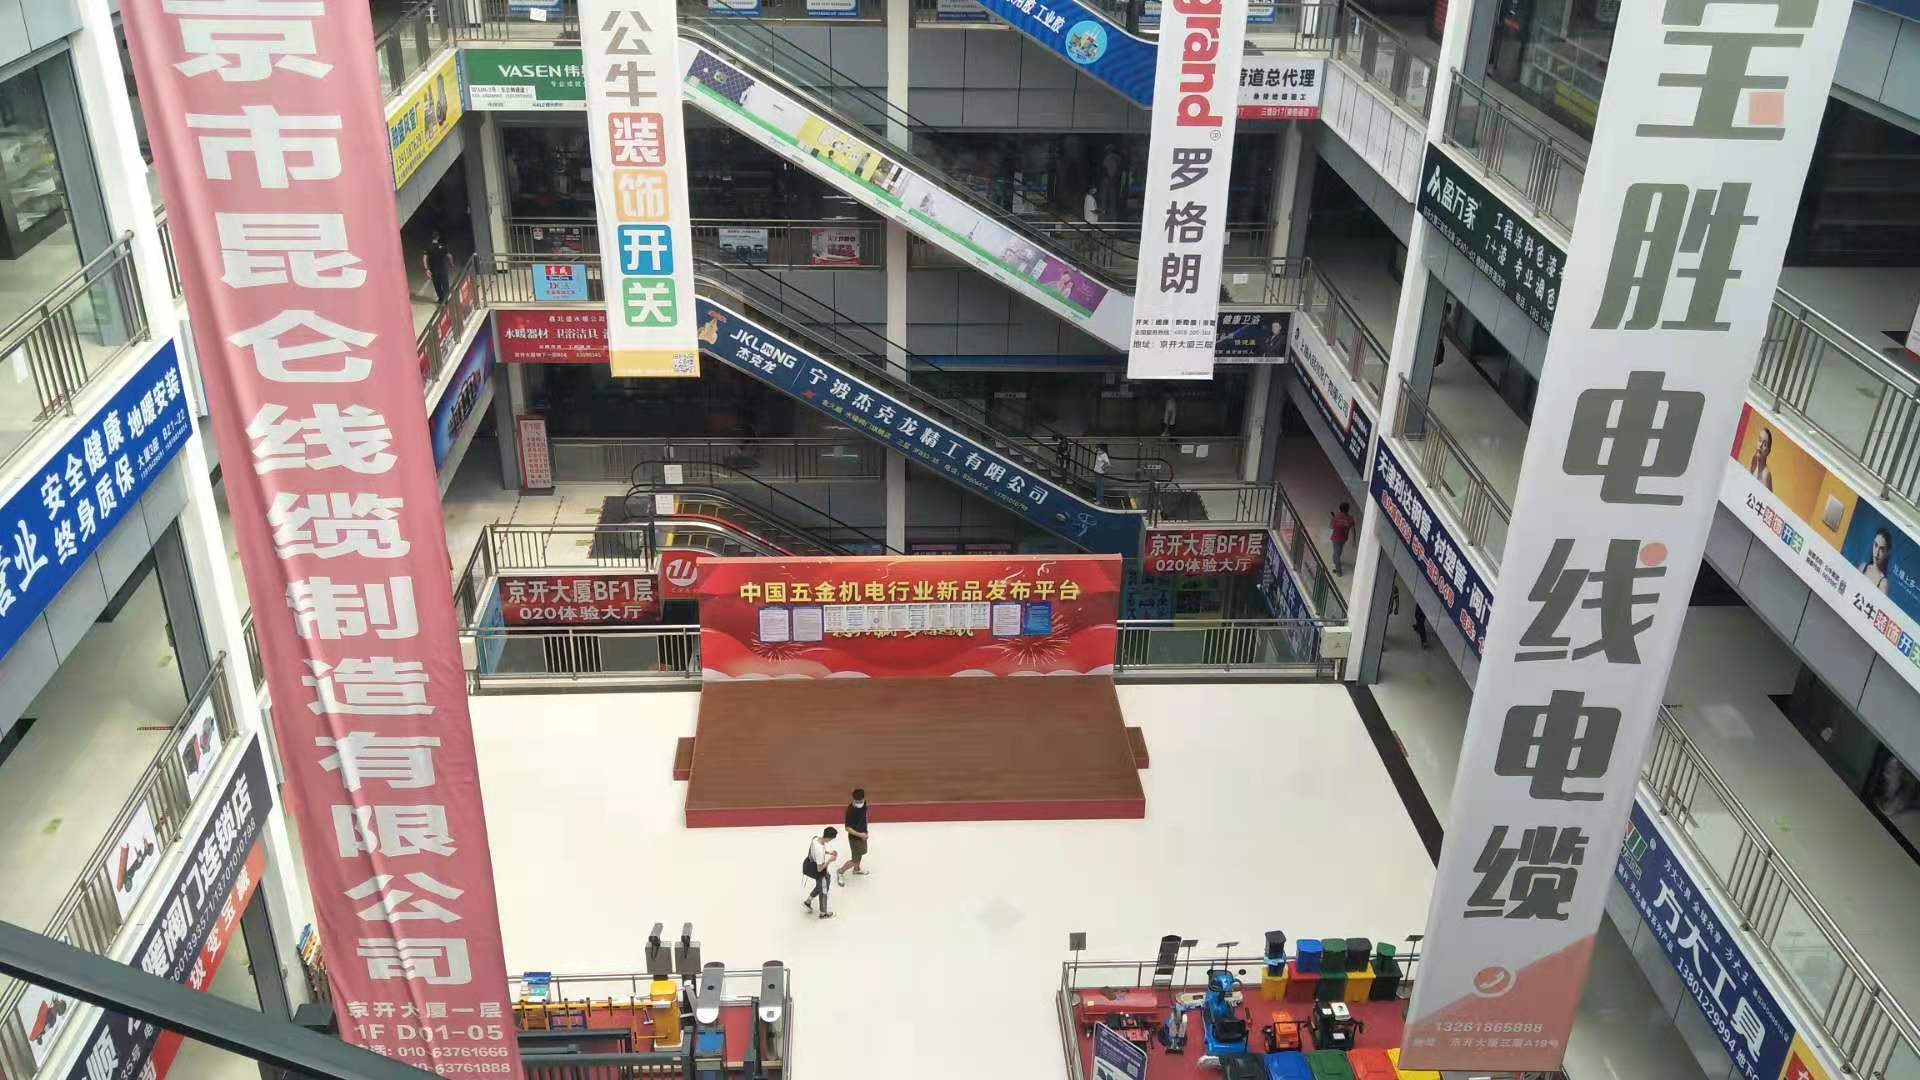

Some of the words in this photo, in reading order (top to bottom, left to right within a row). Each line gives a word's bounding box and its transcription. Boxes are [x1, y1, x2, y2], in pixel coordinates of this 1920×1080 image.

[498, 64, 562, 78] VASEN
[564, 64, 585, 78] 伟
[600, 10, 678, 328] 公牛装饰开关
[1160, 147, 1213, 295] 罗格朗
[1440, 176, 1479, 231] 盈万家
[504, 327, 549, 340] 水暖器材
[553, 327, 599, 340] 卫浴洁具
[735, 346, 778, 375] 杰克龙
[40, 409, 125, 521] 安全健康
[127, 366, 181, 440] 地暖安装
[809, 367, 1049, 505] 宁波杰克龙精工有限公司
[1463, 0, 1820, 921] 宝胜电线电缆
[54, 452, 136, 566] 终身质保
[1150, 532, 1264, 557] 京开大厦BF1层
[506, 578, 654, 603] 京开大厦BF1层
[739, 580, 1082, 604] 中国五金机电行业新品发布平台
[1653, 877, 1767, 1063] 方大工具
[347, 1001, 503, 1018] 京开大厦一层
[1676, 955, 1737, 1052] 13801229994
[354, 1023, 385, 1040] 1F
[396, 1023, 504, 1043] D01-05
[397, 1046, 508, 1059] 010-63761666
